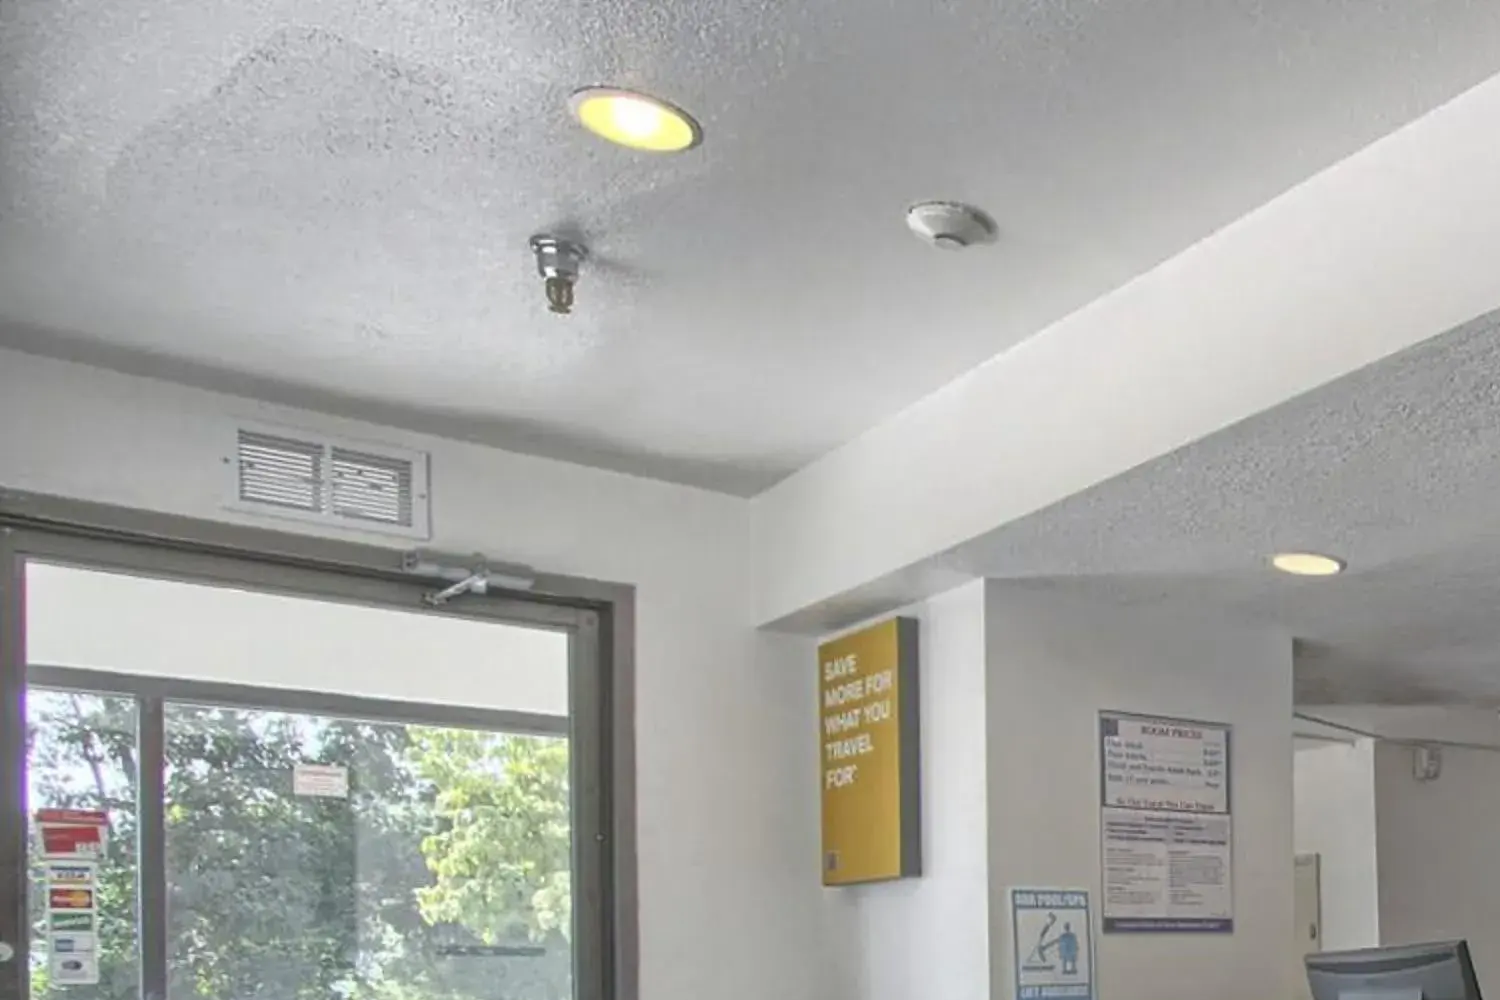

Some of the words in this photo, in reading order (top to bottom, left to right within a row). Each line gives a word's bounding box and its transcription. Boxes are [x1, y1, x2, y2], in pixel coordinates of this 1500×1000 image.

[825, 654, 857, 681] SAVE
[825, 680, 864, 707] MORE
[865, 669, 892, 695] FOR
[825, 709, 861, 736] WHAT
[863, 700, 890, 723] YOU
[825, 733, 874, 760] TRAVEL
